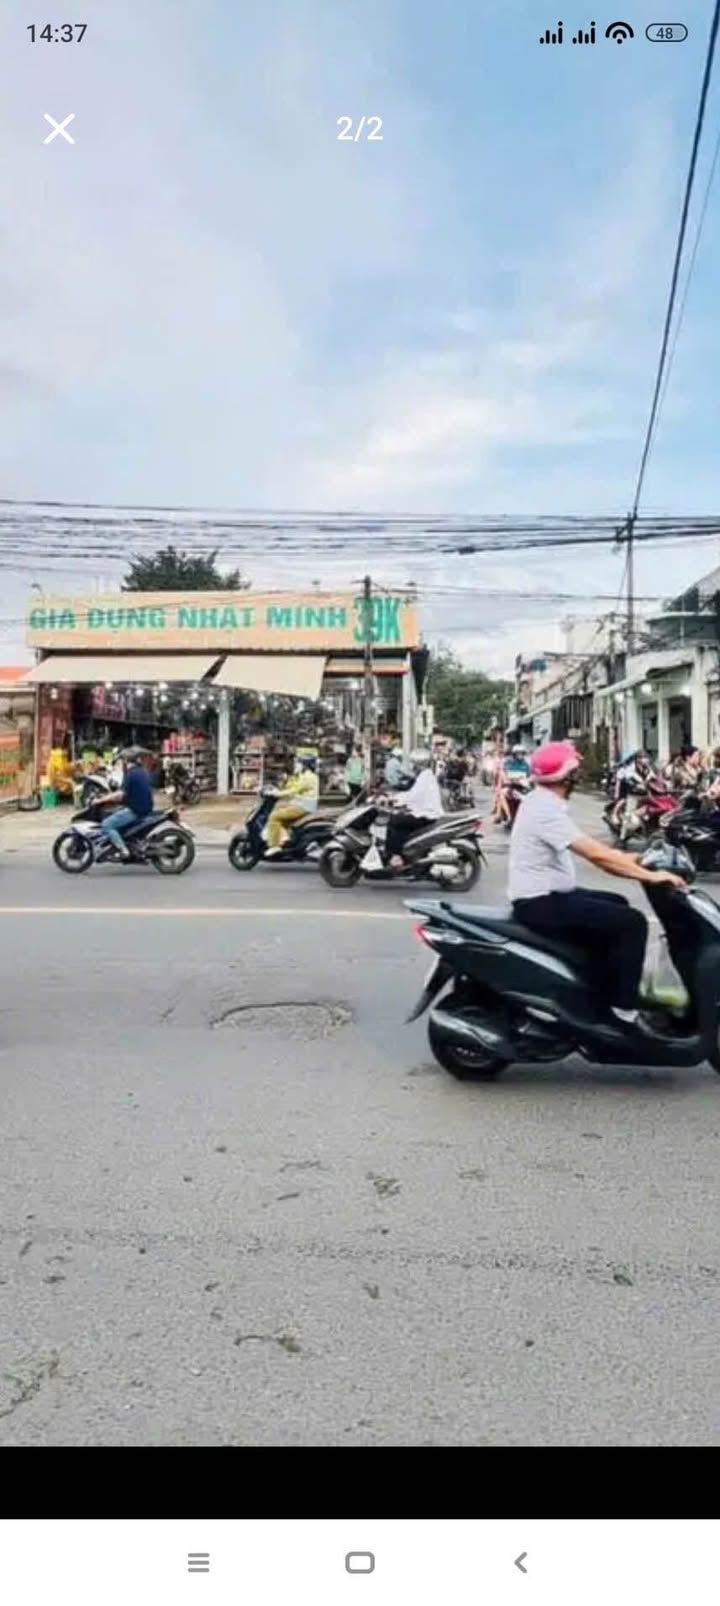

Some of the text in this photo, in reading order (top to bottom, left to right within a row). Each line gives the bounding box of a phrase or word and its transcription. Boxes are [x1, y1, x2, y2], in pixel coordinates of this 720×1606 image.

[30, 608, 75, 629] GIA
[267, 606, 346, 628] MINH
[353, 597, 401, 642] 39K
